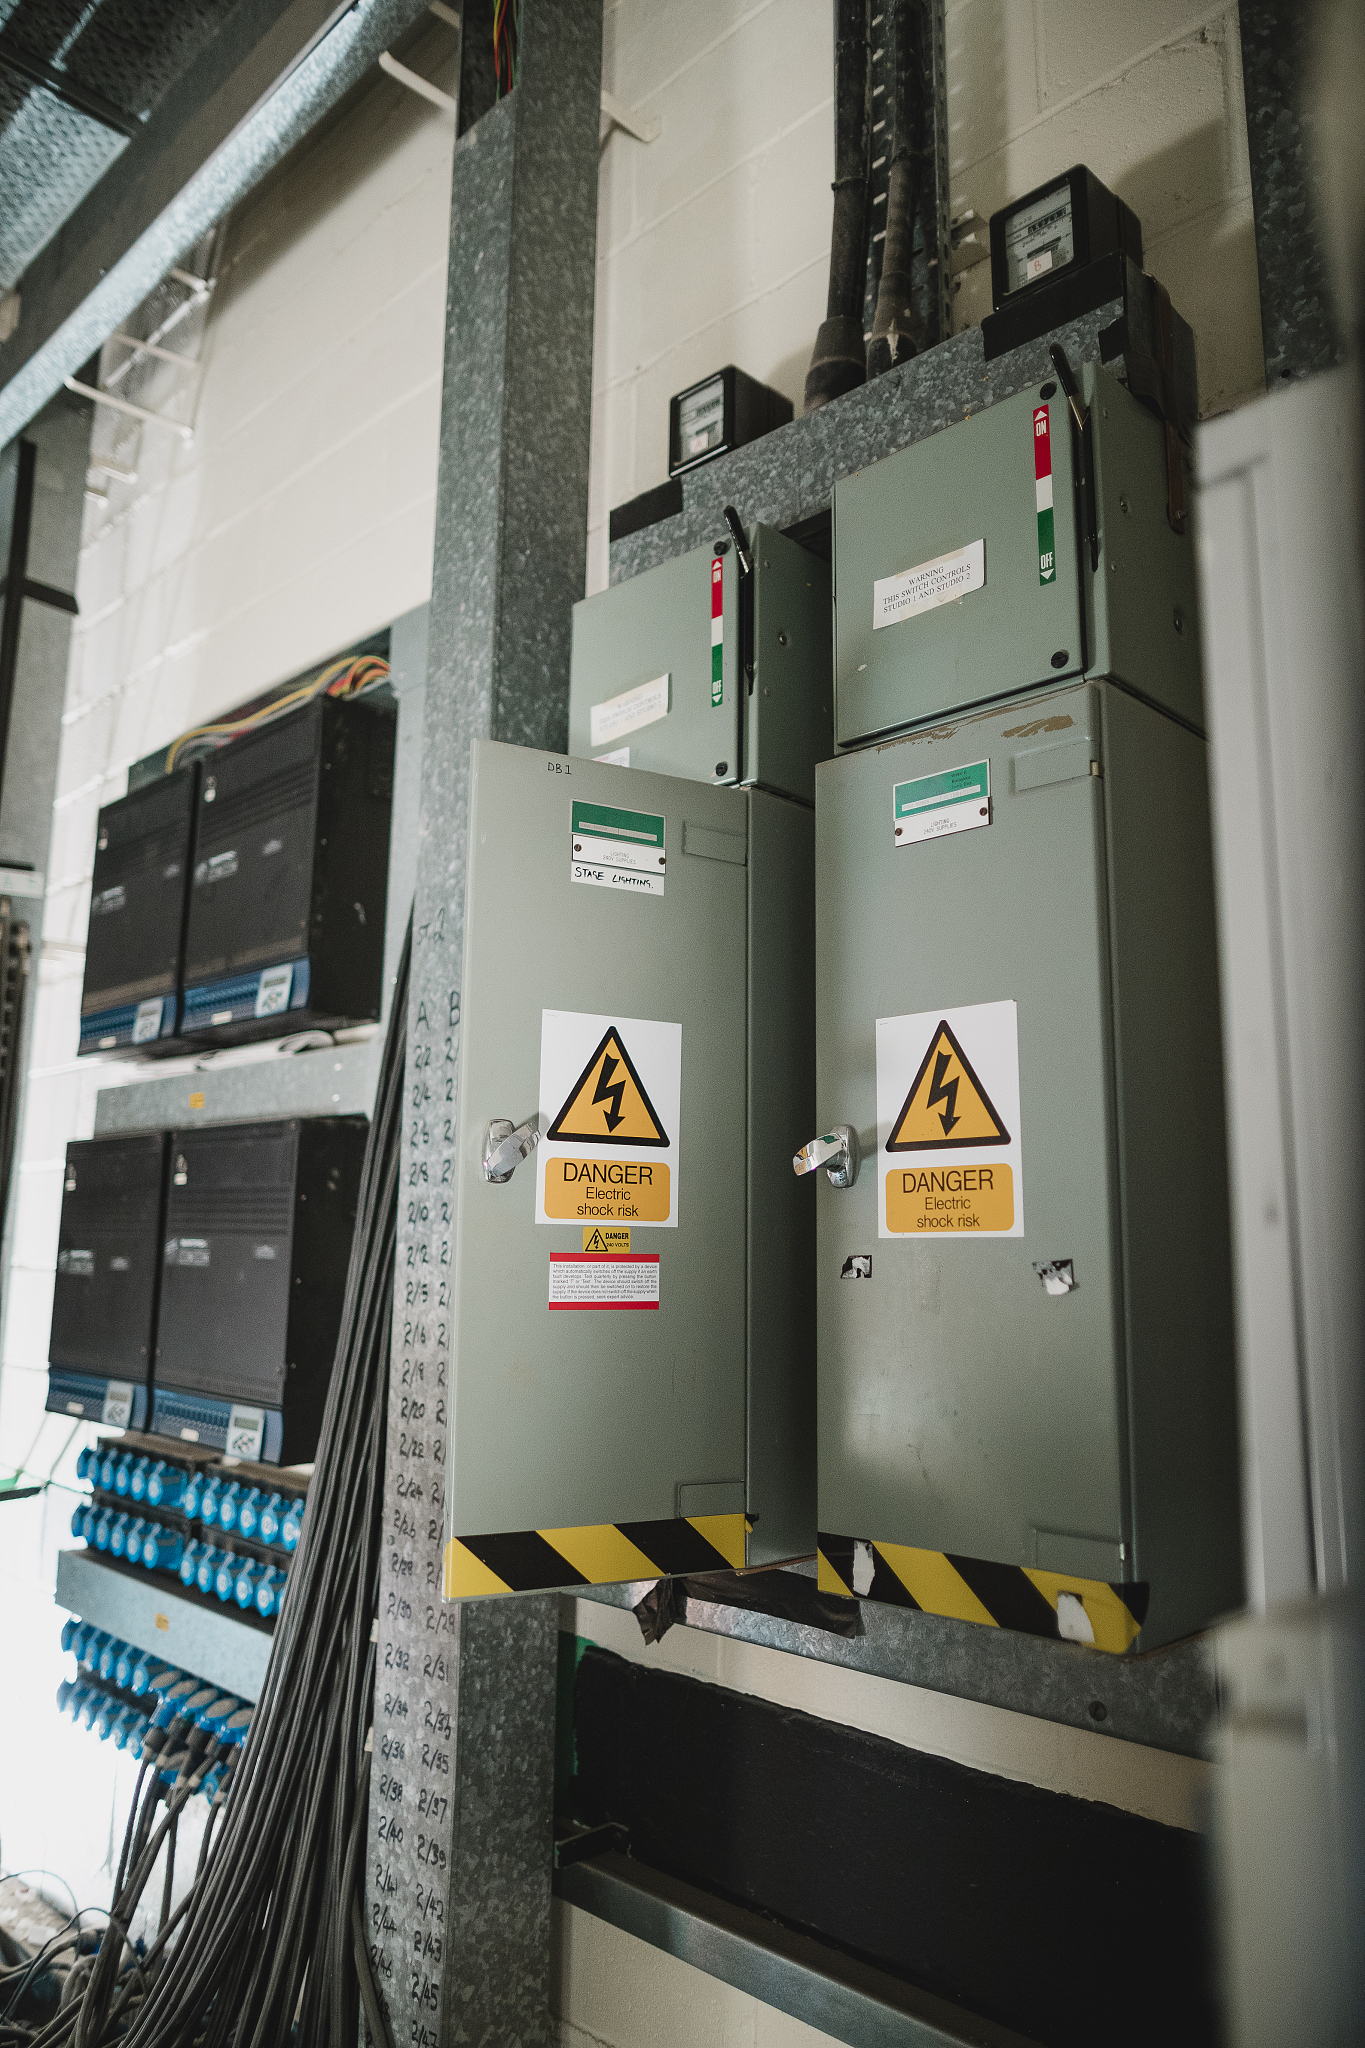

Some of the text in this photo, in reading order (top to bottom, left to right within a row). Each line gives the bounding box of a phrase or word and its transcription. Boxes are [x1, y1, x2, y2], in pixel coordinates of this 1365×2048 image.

[1033, 260, 1042, 272] B
[1036, 419, 1047, 437] ON
[1040, 552, 1053, 570] OFF
[712, 568, 722, 583] ON
[883, 563, 971, 605] THIS SWITCH CONTROLS
[908, 566, 944, 586] WARNING
[883, 597, 911, 614] STUDIO
[919, 588, 935, 600] AND
[936, 575, 964, 593] STUDIO
[966, 572, 971, 580] 2
[712, 679, 722, 695] OFF
[930, 818, 950, 828] LIGHTING
[936, 822, 957, 832] SUPPLIES
[610, 851, 629, 859] LIGHTING
[616, 856, 636, 865] SUPPLIES
[574, 866, 605, 881] STAGE
[414, 1001, 430, 1033] A
[449, 990, 460, 1027] B
[563, 1161, 654, 1186] DANGER
[902, 1168, 995, 1194] DANGER
[586, 1186, 632, 1201] Electric
[925, 1196, 972, 1211] Electric
[576, 1203, 639, 1217] shock risk
[916, 1213, 981, 1229] shock risk
[605, 1232, 629, 1240] DANGER
[401, 1397, 426, 1425] 2/20
[400, 1433, 425, 1460] 2/22
[426, 1605, 456, 1634] 2/29
[385, 1643, 410, 1671] 2/32
[424, 1653, 449, 1683] 2/31
[384, 1693, 409, 1721] 2/34
[381, 1735, 405, 1761] 2/36
[422, 1744, 449, 1775] 2/35
[380, 1774, 403, 1803] 2/38
[418, 1789, 448, 1825] 2/37
[378, 1816, 404, 1843] 2/40
[417, 1834, 447, 1870] 2/39
[375, 1864, 398, 1898] 2/41
[416, 1883, 444, 1923] 2/42
[372, 1903, 397, 1938] 2/44
[414, 1931, 443, 1964] 2/43
[412, 1972, 440, 2012] 2/45
[411, 2019, 438, 2048] 2/47
